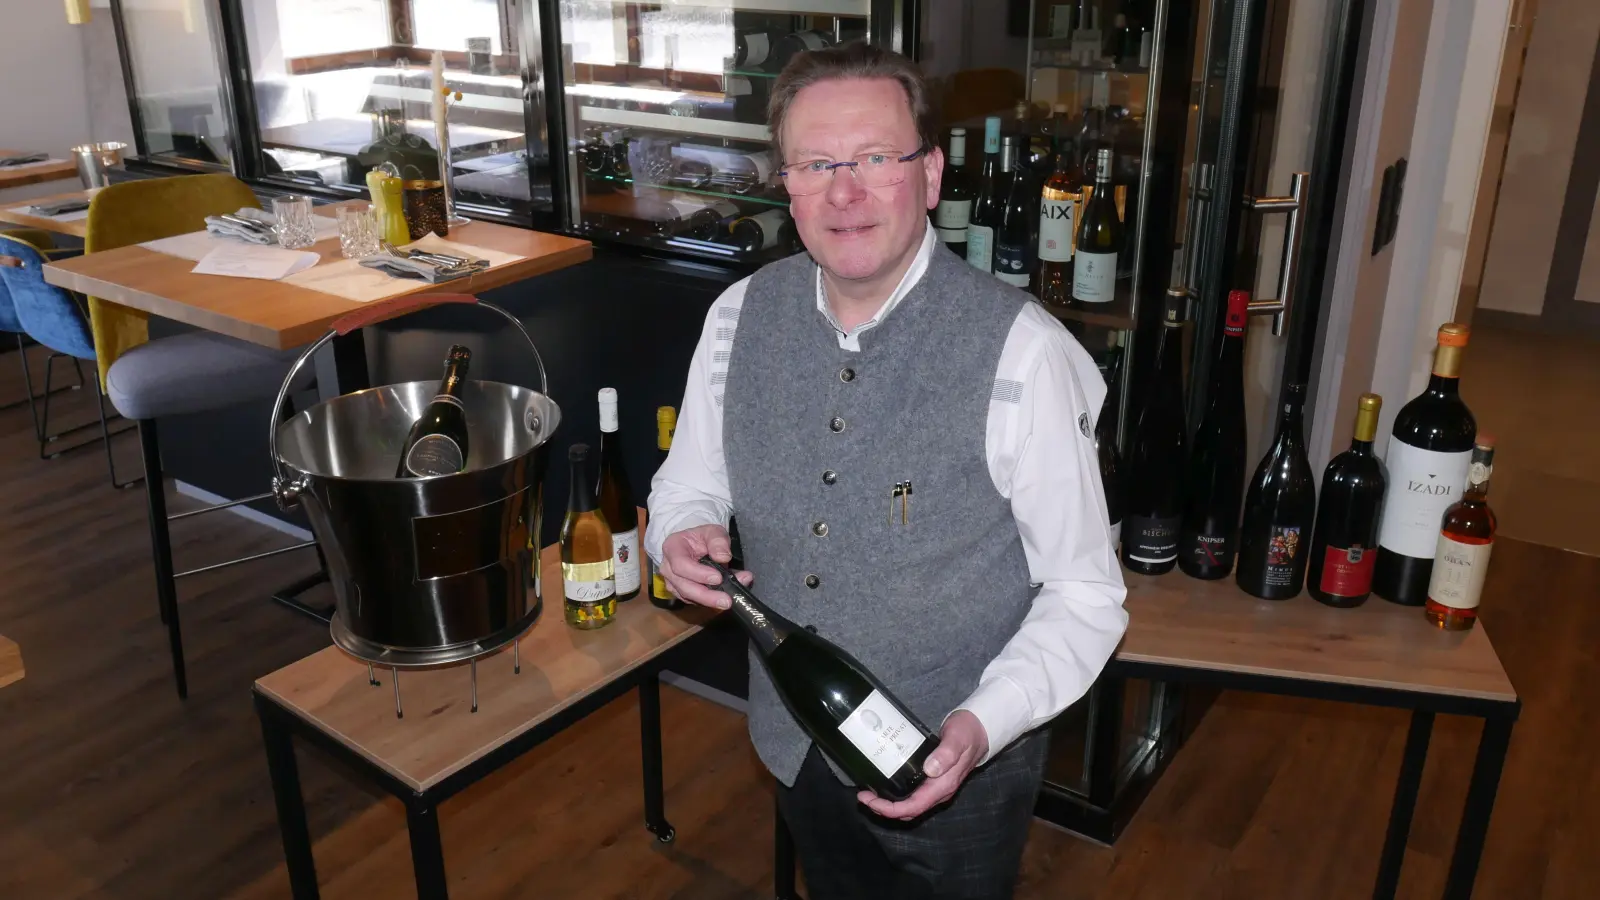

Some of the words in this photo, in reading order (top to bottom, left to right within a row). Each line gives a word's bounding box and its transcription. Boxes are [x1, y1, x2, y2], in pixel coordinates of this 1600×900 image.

[1040, 203, 1071, 220] AIX
[1407, 480, 1452, 496] IZADI
[1142, 529, 1173, 537] BISCH
[1197, 536, 1225, 544] KNIPSER
